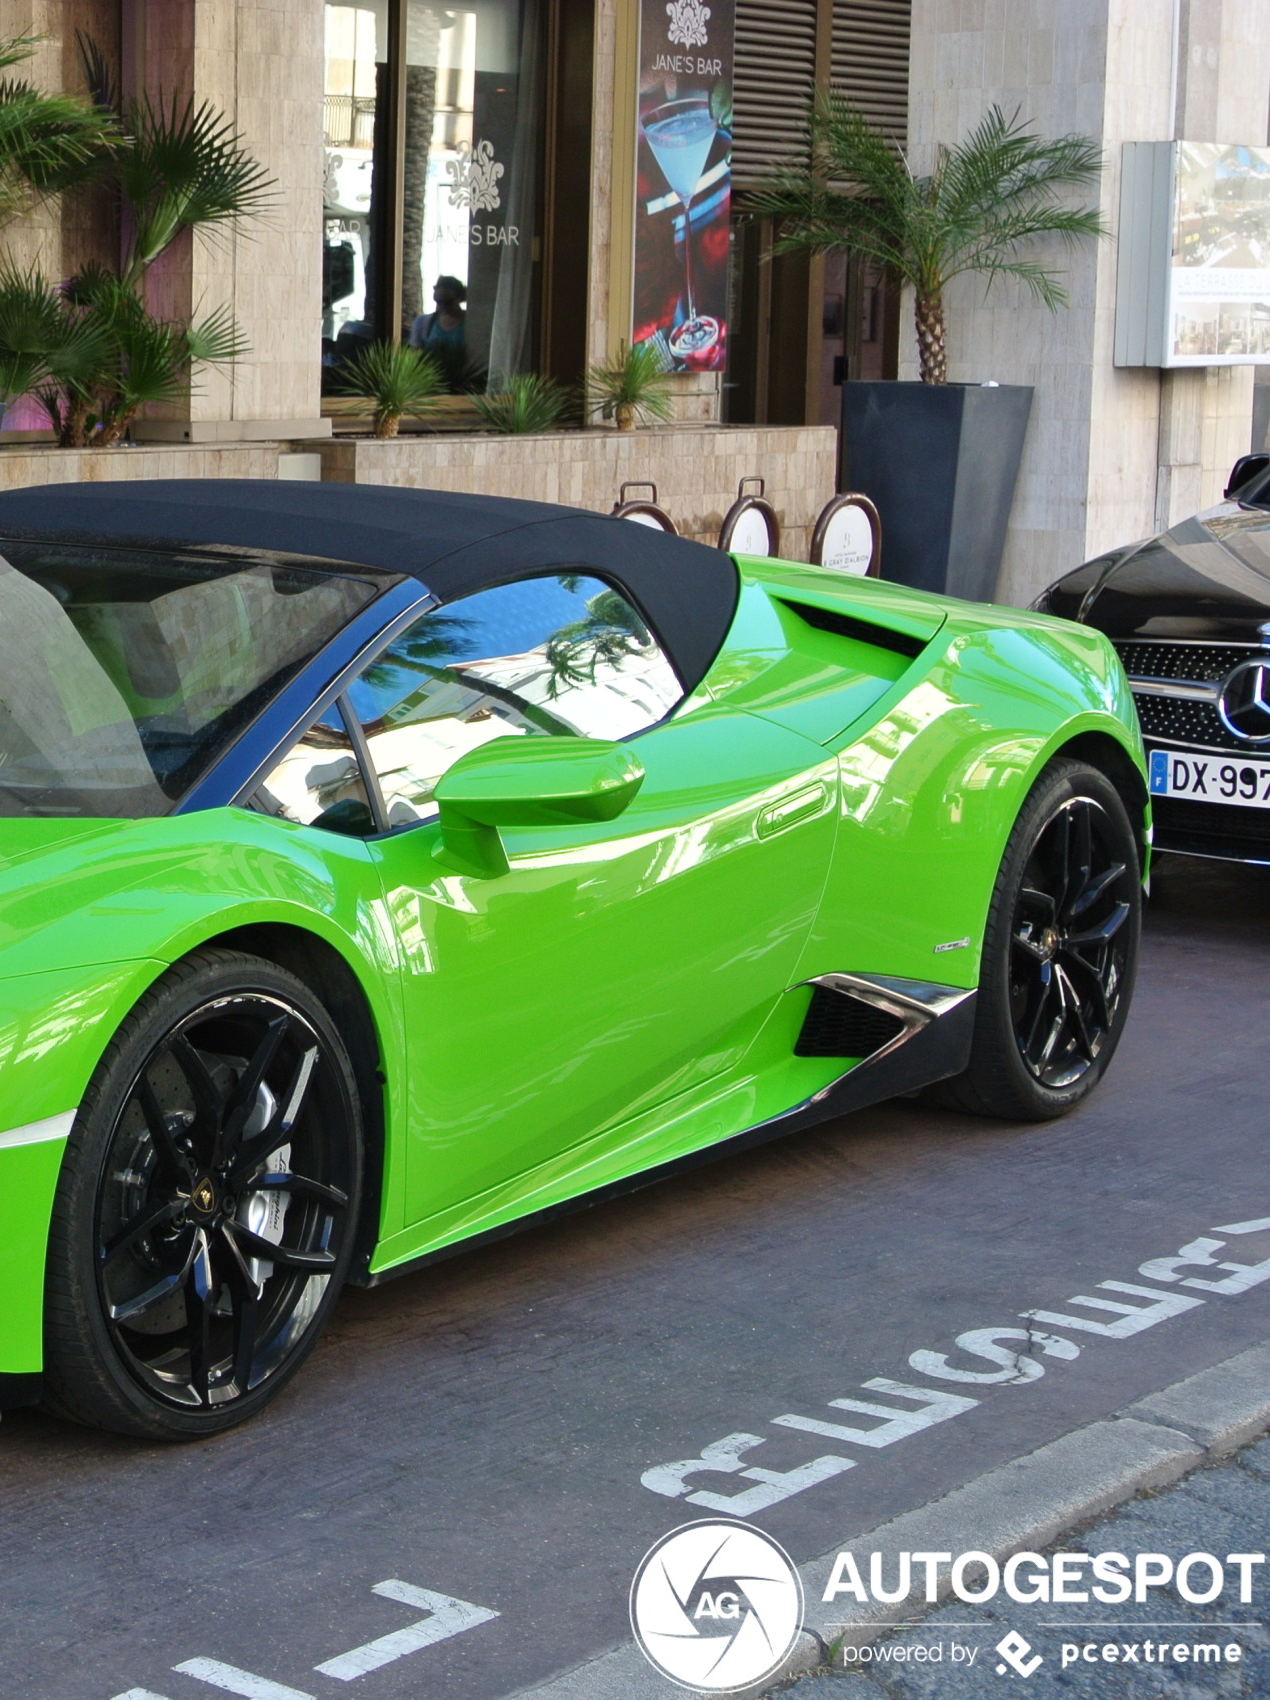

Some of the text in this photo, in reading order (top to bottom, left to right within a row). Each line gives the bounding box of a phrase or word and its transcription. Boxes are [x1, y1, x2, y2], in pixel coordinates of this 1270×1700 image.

[651, 54, 723, 76] JANE'S BAR
[426, 225, 520, 246] JANE'S BAR
[1155, 777, 1162, 787] F
